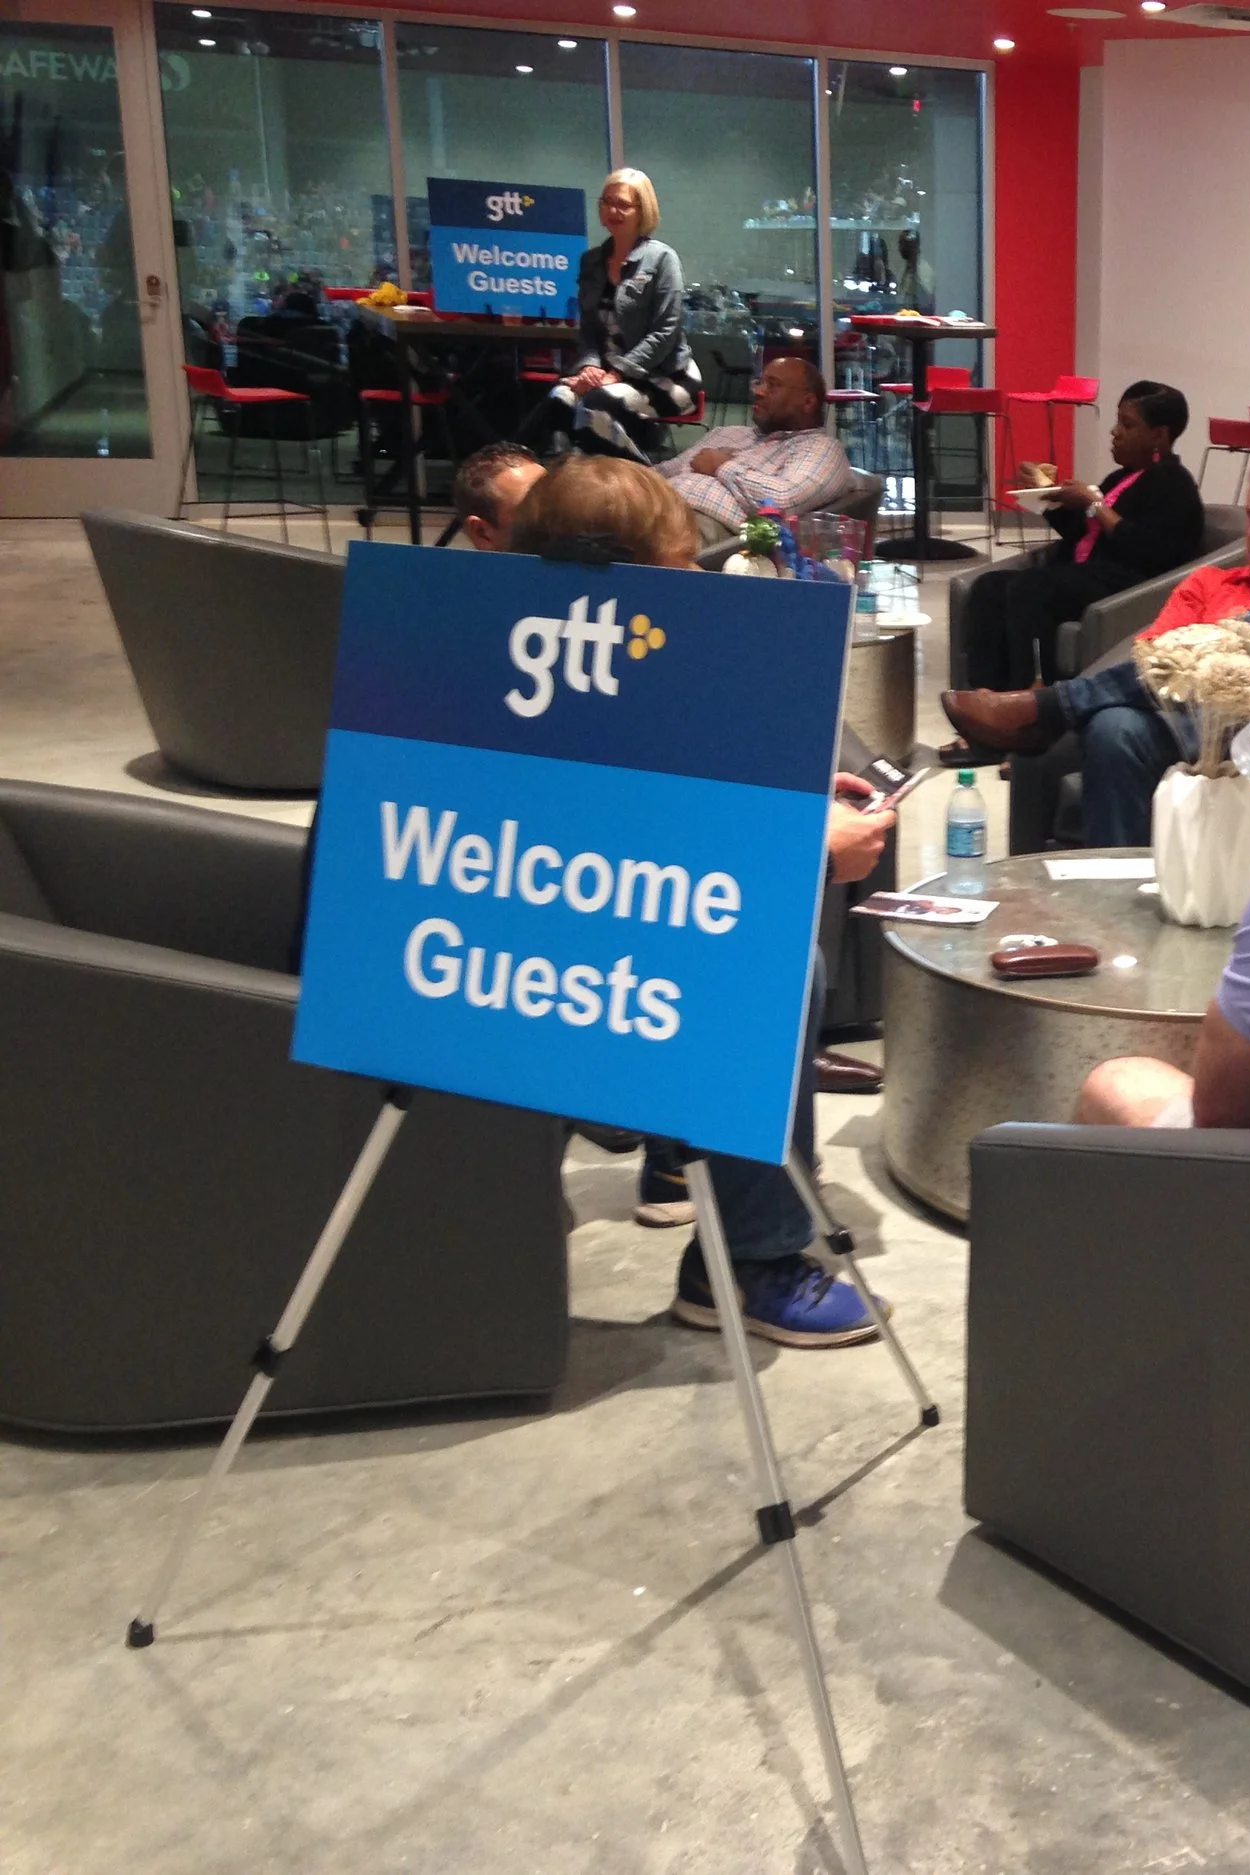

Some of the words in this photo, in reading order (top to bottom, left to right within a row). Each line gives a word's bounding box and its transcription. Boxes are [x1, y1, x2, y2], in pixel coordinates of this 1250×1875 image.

[0, 49, 118, 83] AFEWA
[486, 191, 523, 222] gtt
[452, 243, 569, 270] Welcome
[468, 270, 558, 296] Guests
[504, 595, 625, 718] gtt
[380, 801, 741, 935] Welcome
[404, 917, 682, 1041] Guests
